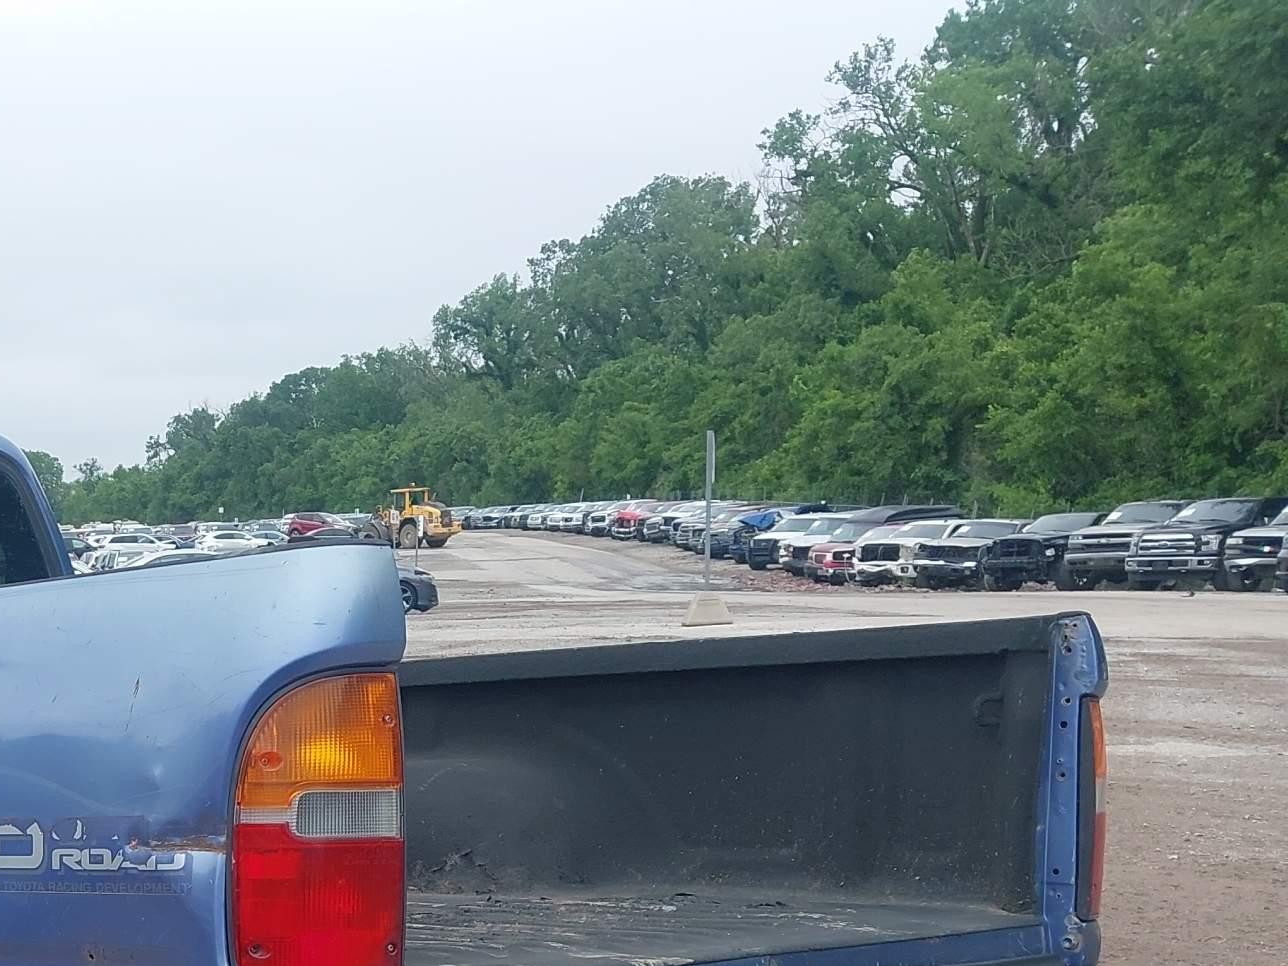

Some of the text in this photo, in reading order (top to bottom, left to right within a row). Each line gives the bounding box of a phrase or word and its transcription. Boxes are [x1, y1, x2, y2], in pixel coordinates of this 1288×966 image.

[3, 880, 191, 895] TOYOTA RACING DEVELOPMENT
